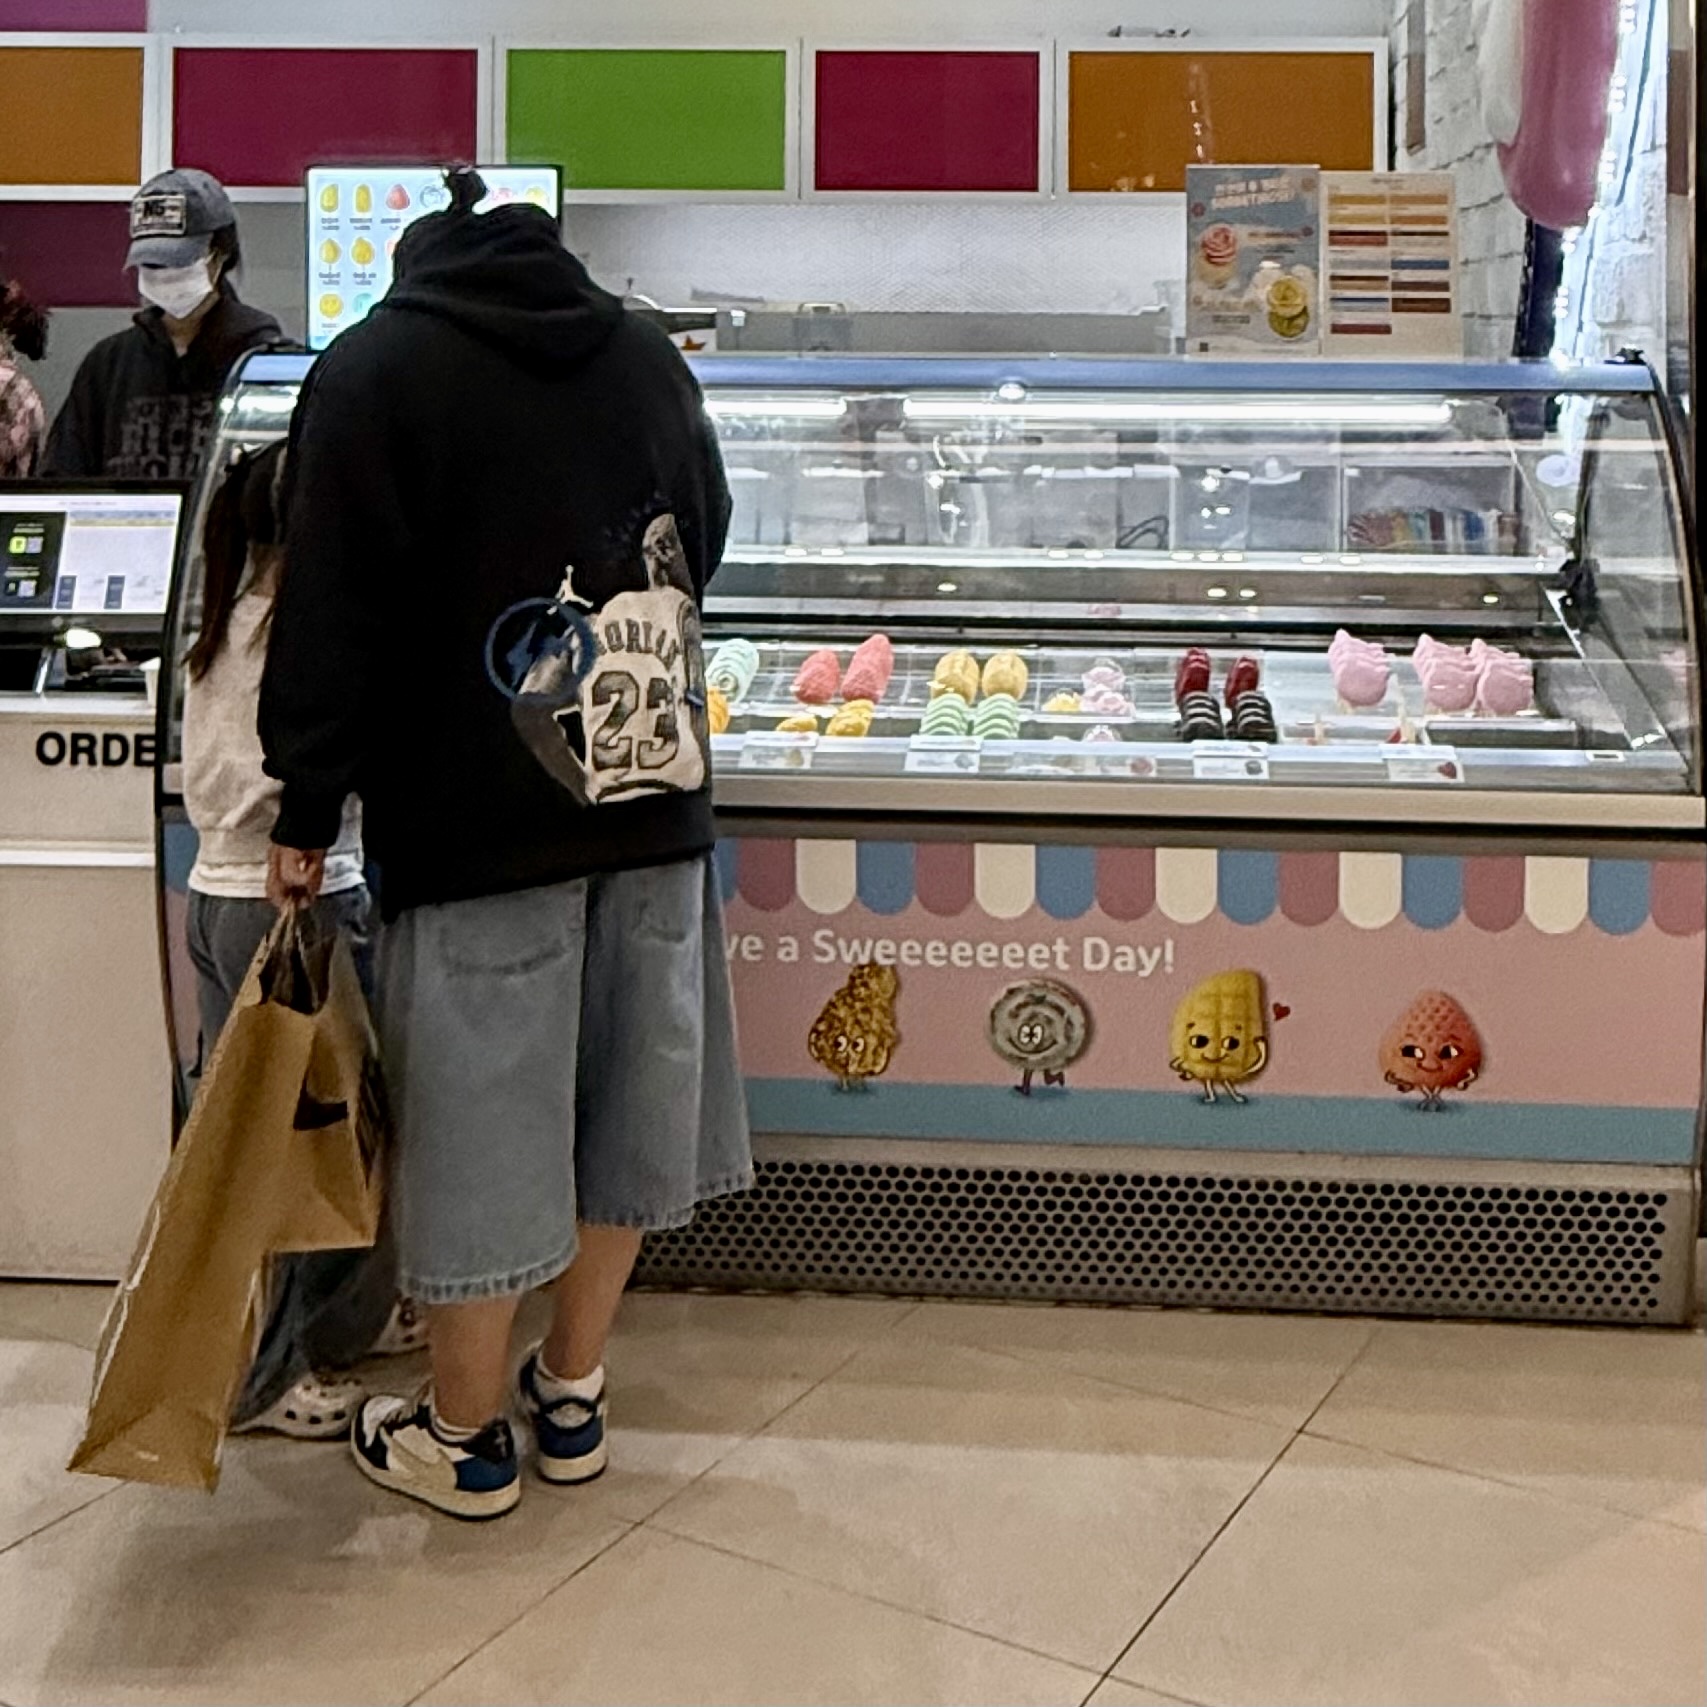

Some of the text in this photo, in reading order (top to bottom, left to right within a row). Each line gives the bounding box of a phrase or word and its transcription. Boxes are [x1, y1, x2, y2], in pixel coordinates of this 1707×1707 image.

[591, 670, 680, 770] 23
[777, 934, 799, 963] a
[812, 928, 1070, 971] Sweeeeeeet
[1082, 936, 1175, 978] Day!
